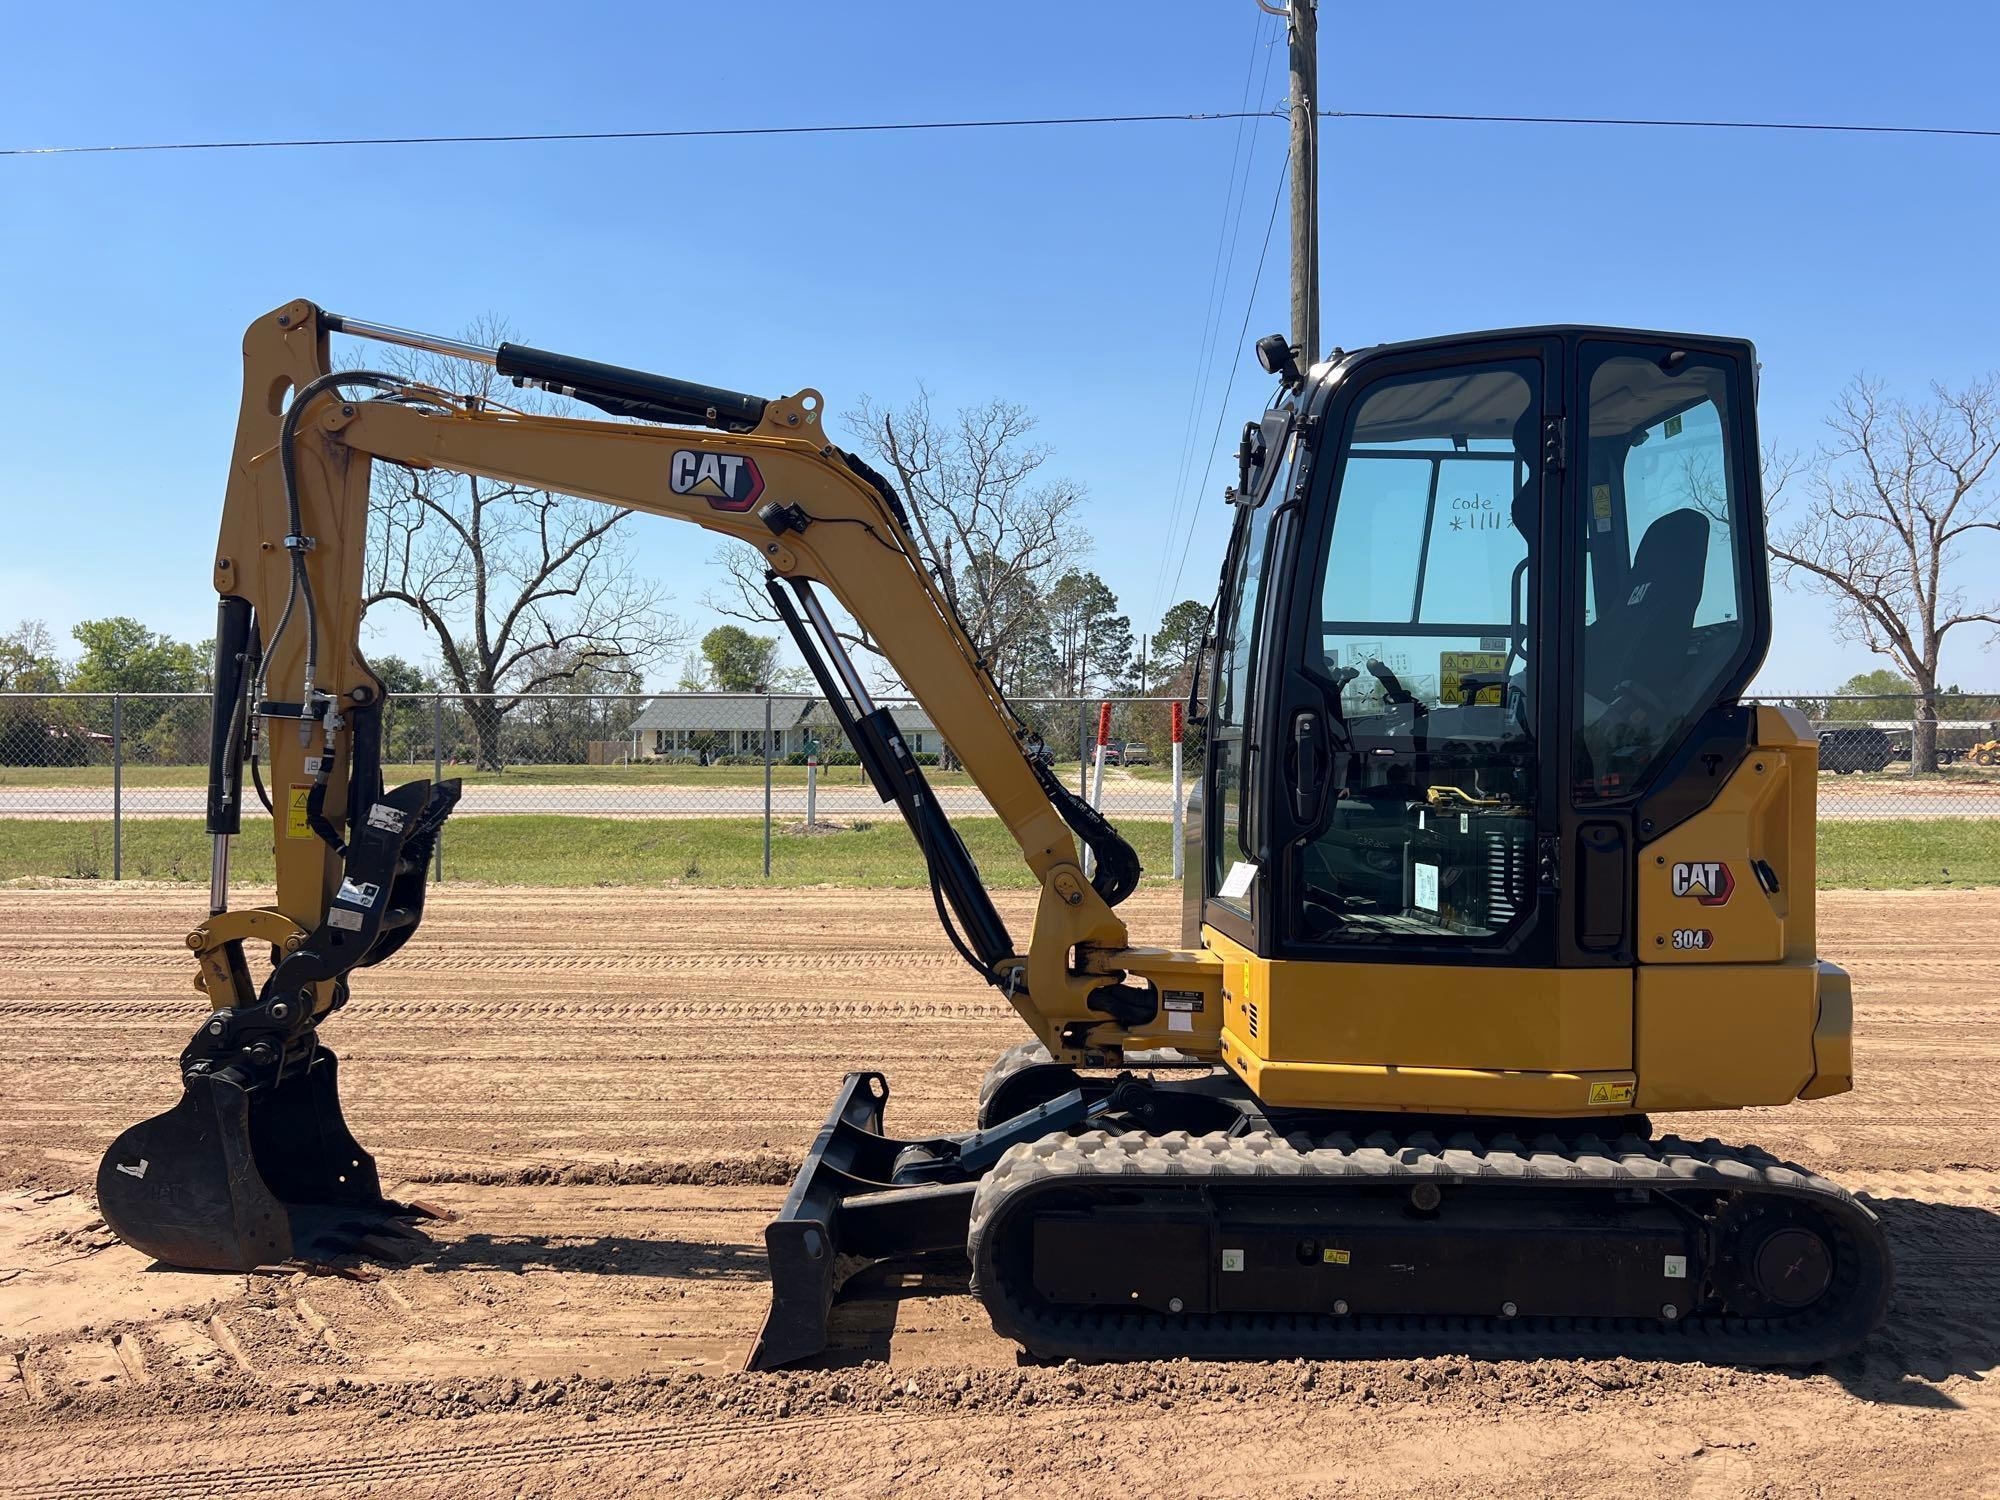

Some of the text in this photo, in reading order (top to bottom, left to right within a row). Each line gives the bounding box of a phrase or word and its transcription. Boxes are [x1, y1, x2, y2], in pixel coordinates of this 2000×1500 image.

[671, 450, 744, 498] CAT
[1673, 863, 1720, 896] CAT
[1672, 930, 1704, 949] 304
